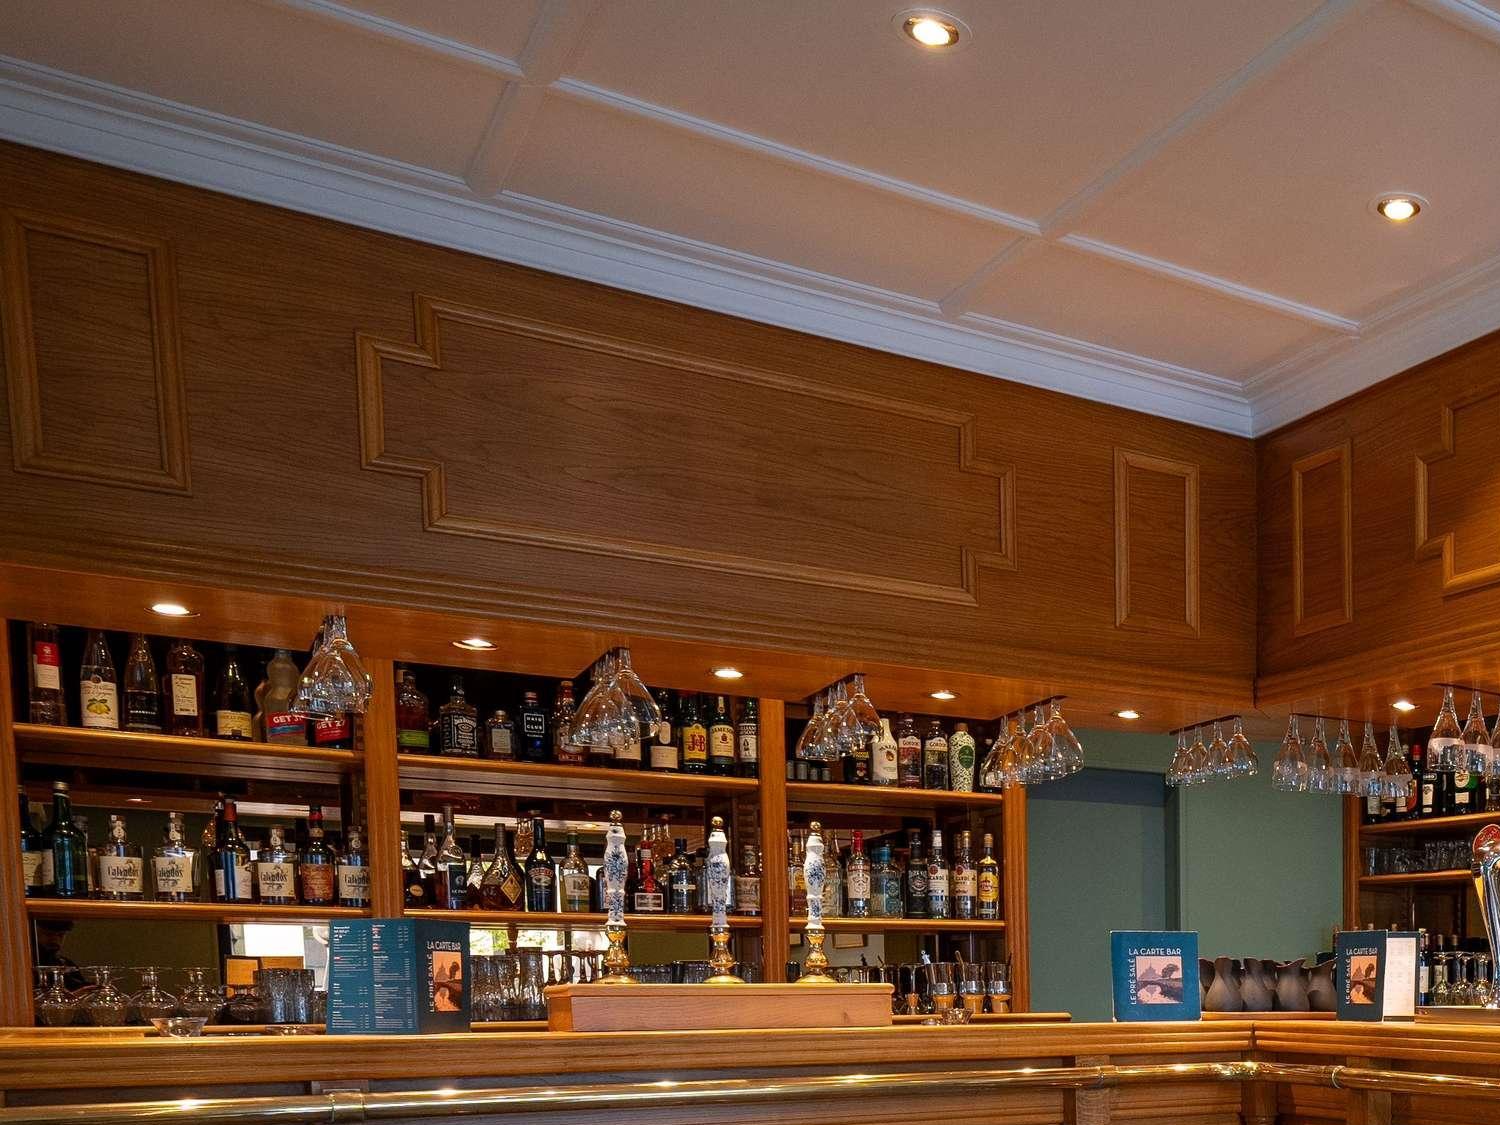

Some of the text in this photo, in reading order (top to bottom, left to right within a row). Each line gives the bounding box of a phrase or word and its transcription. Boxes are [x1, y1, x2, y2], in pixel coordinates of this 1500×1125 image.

[273, 715, 291, 724] GET
[687, 733, 706, 752] J&B
[345, 873, 369, 884] Calvado
[1128, 947, 1182, 956] LA CARTE BAR
